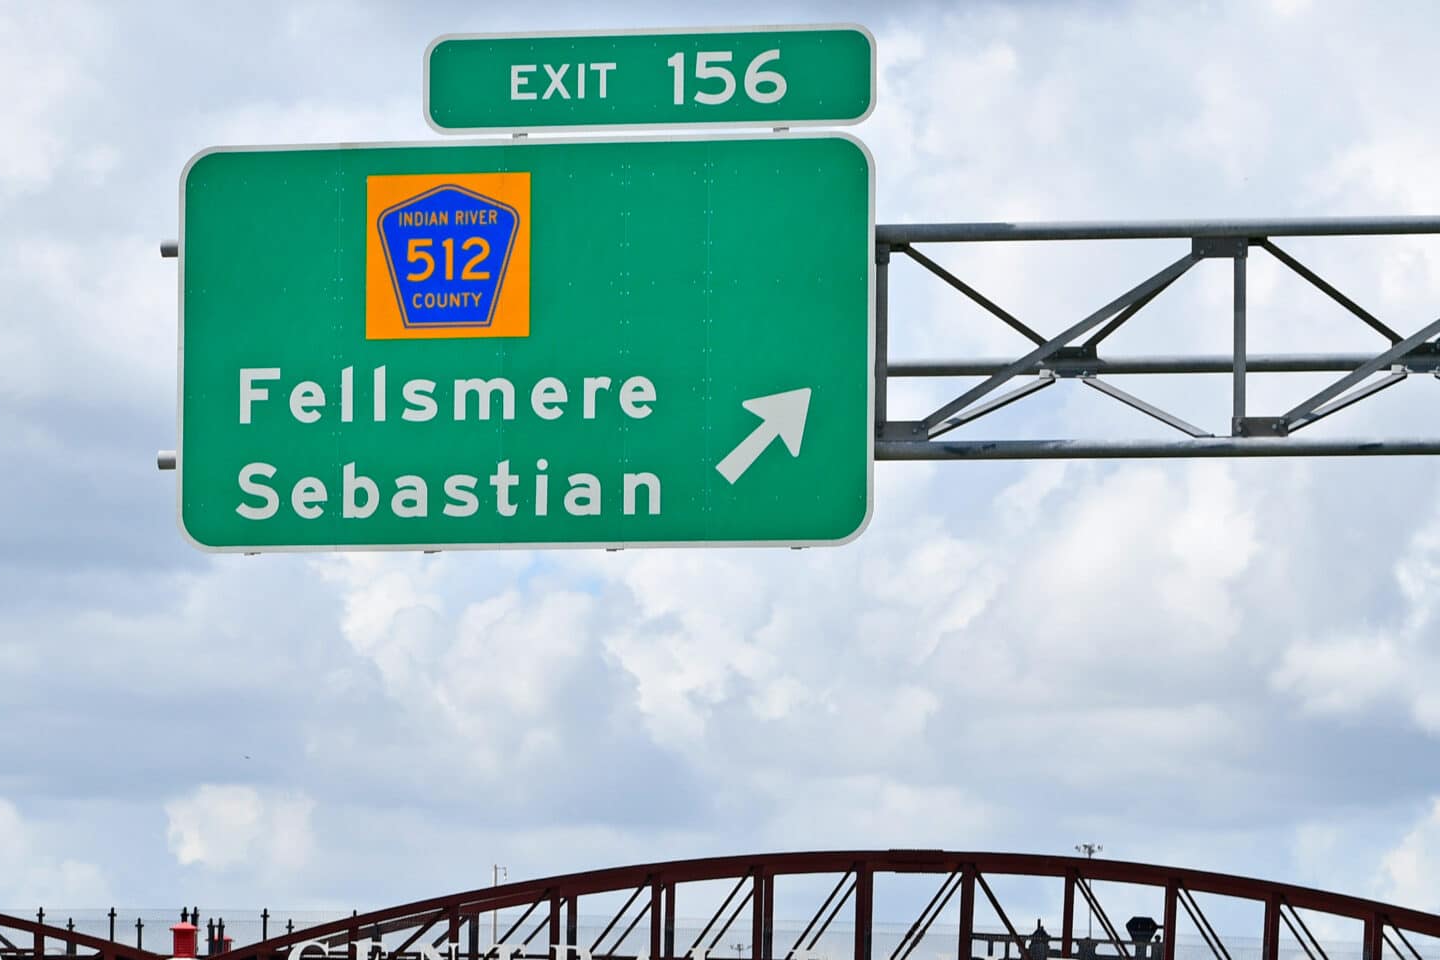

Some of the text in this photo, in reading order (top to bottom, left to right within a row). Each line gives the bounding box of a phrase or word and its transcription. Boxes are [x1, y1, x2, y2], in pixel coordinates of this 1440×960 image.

[510, 50, 787, 105] EXIT 156
[398, 208, 498, 227] INDIAN RIVER
[406, 237, 490, 282] 512
[412, 292, 482, 309] COUNTY
[238, 365, 657, 424] Fellsmere
[235, 459, 662, 520] Sebastian
